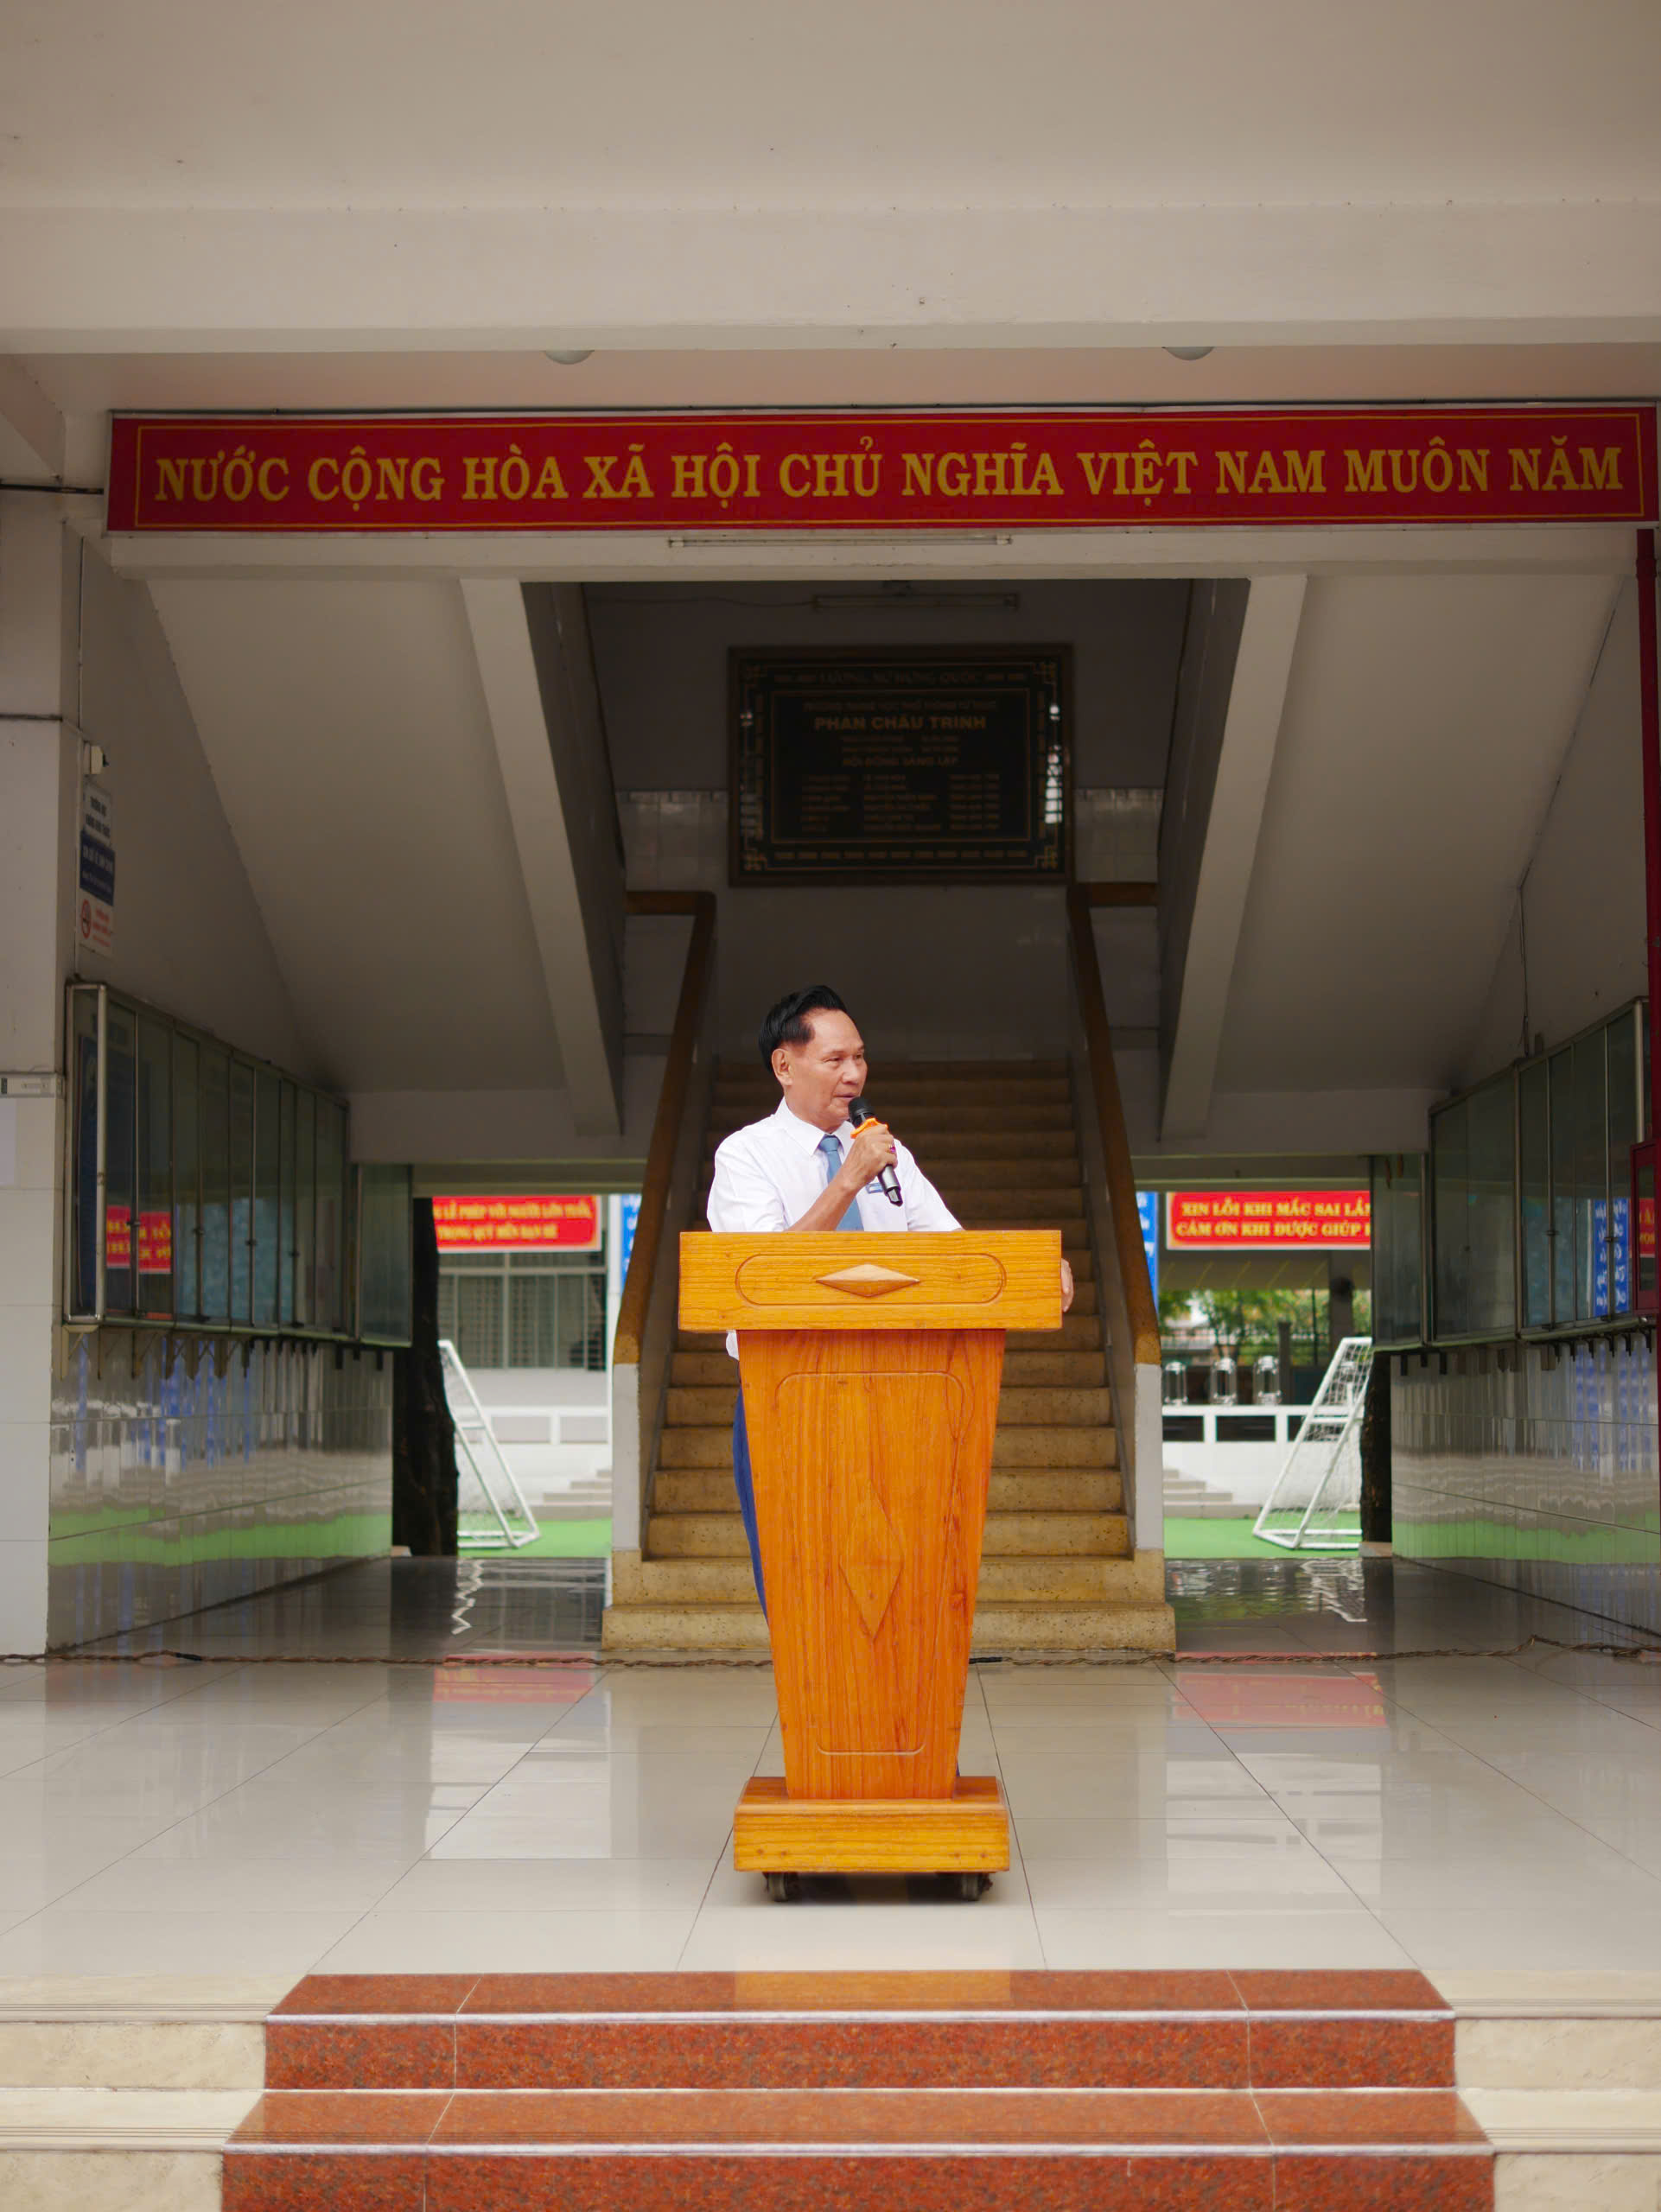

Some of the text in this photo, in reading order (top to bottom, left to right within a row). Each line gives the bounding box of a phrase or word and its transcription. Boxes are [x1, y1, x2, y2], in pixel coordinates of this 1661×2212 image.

[154, 435, 1623, 512] NƯỚC CỘNG HÒA XÃ HỘI CHỦ NGHĨA VIỆT NAM MUÔN NĂM
[814, 716, 865, 731] PHAN
[930, 715, 987, 729] TRINH
[1181, 1202, 1210, 1217] XIN
[1244, 1202, 1272, 1217] KHI
[1314, 1202, 1340, 1217] SAI
[1241, 1222, 1270, 1236] KHI
